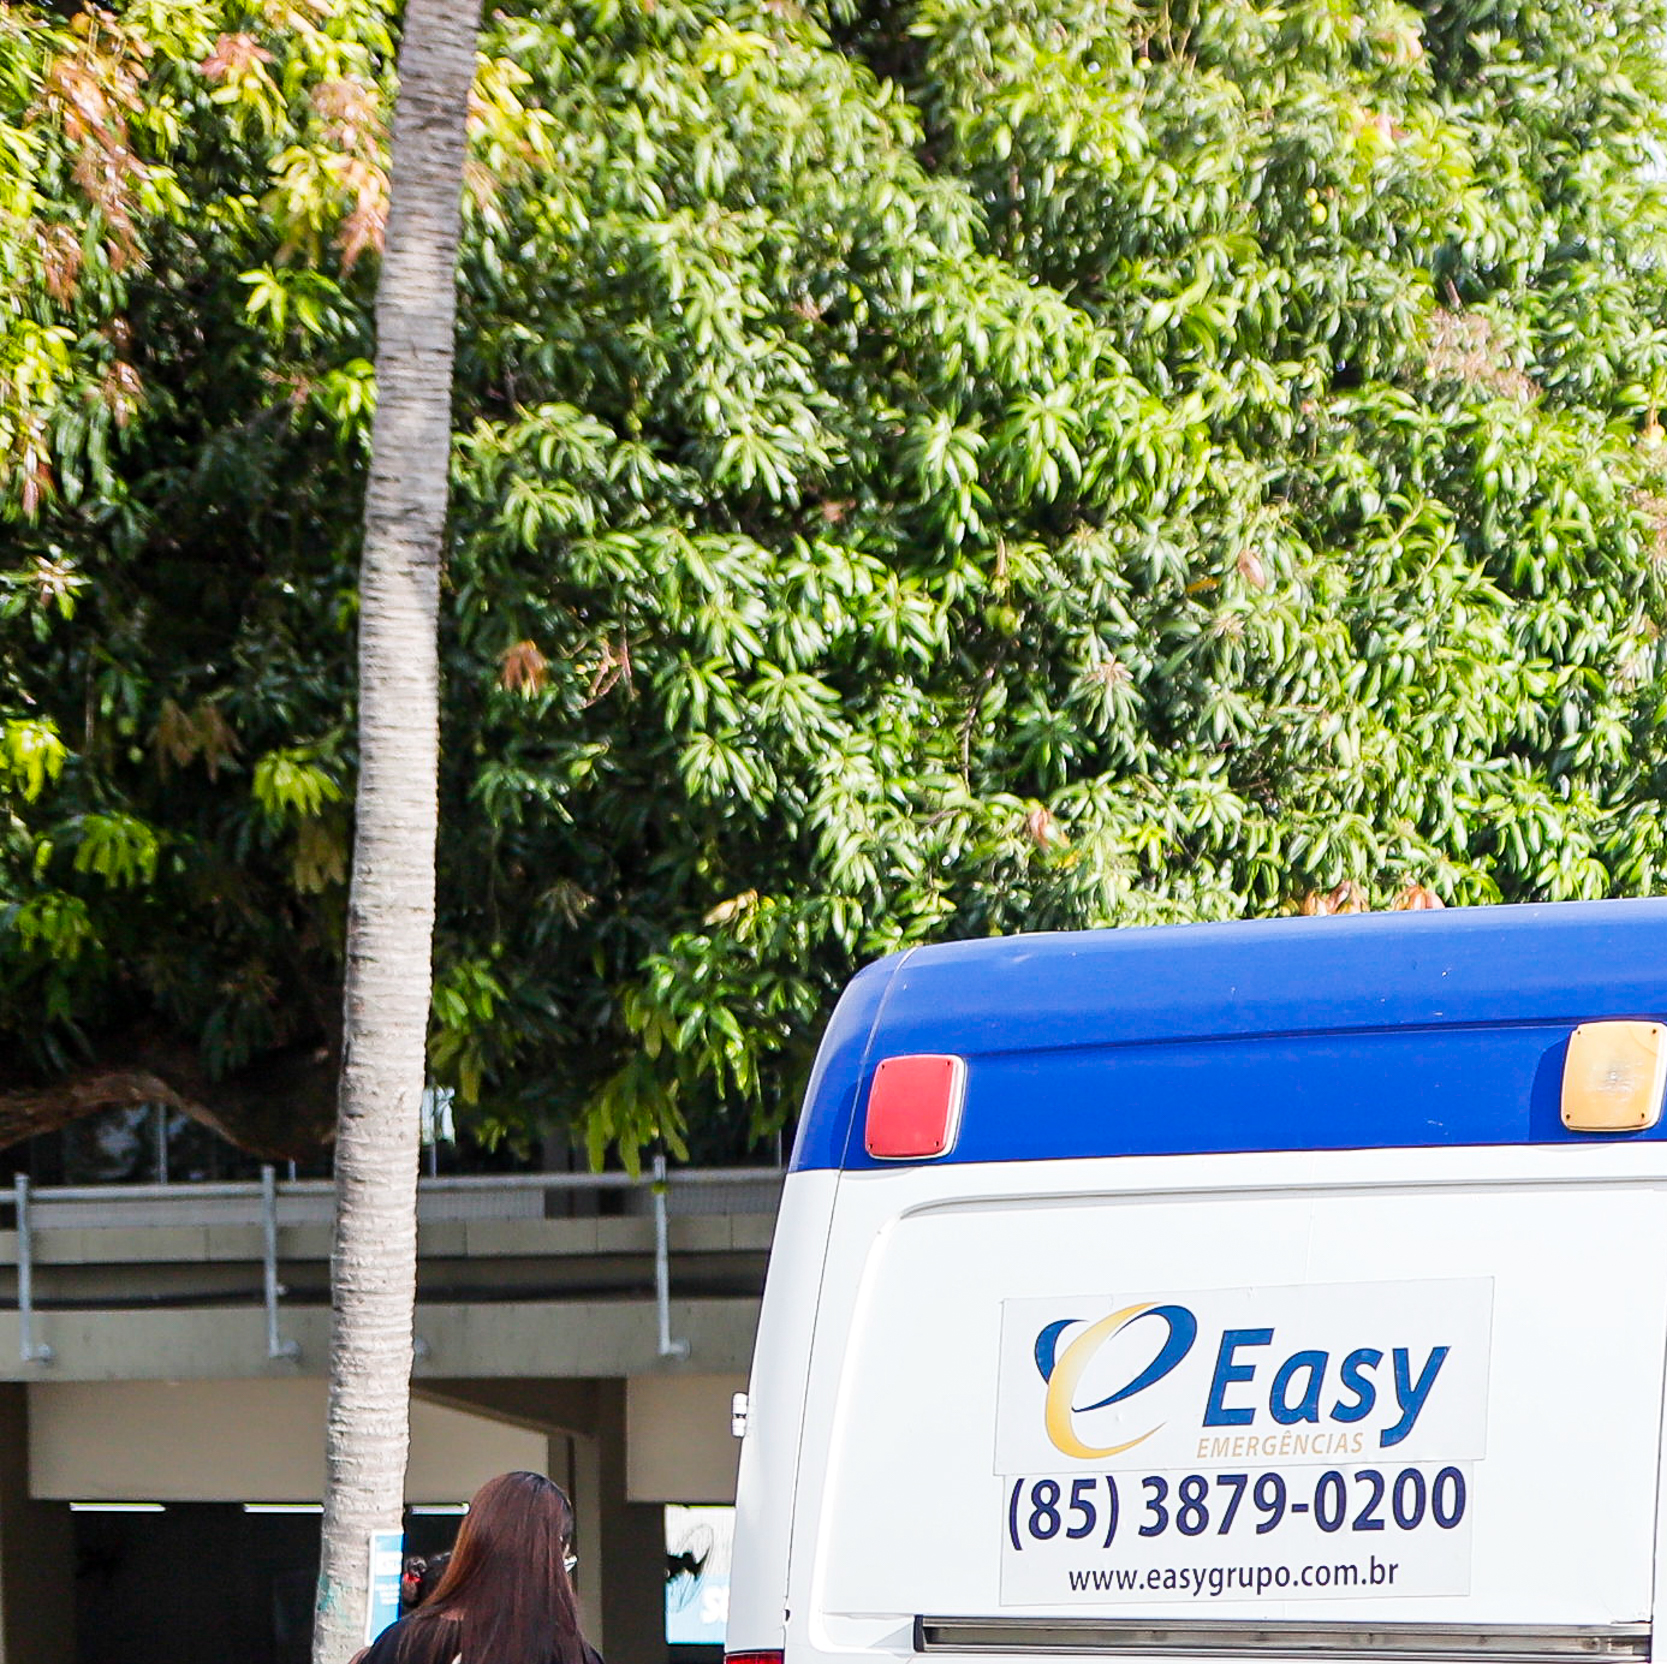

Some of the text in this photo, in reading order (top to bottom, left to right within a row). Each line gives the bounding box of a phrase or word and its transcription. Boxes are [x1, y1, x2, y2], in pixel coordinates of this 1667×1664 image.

[1202, 1327, 1451, 1449] Easy
[1196, 1427, 1364, 1459] EMERGÊNCIAS
[1009, 1465, 1467, 1552] (85) 3879-0200
[1068, 1554, 1399, 1597] www.easygrupo.com.br
